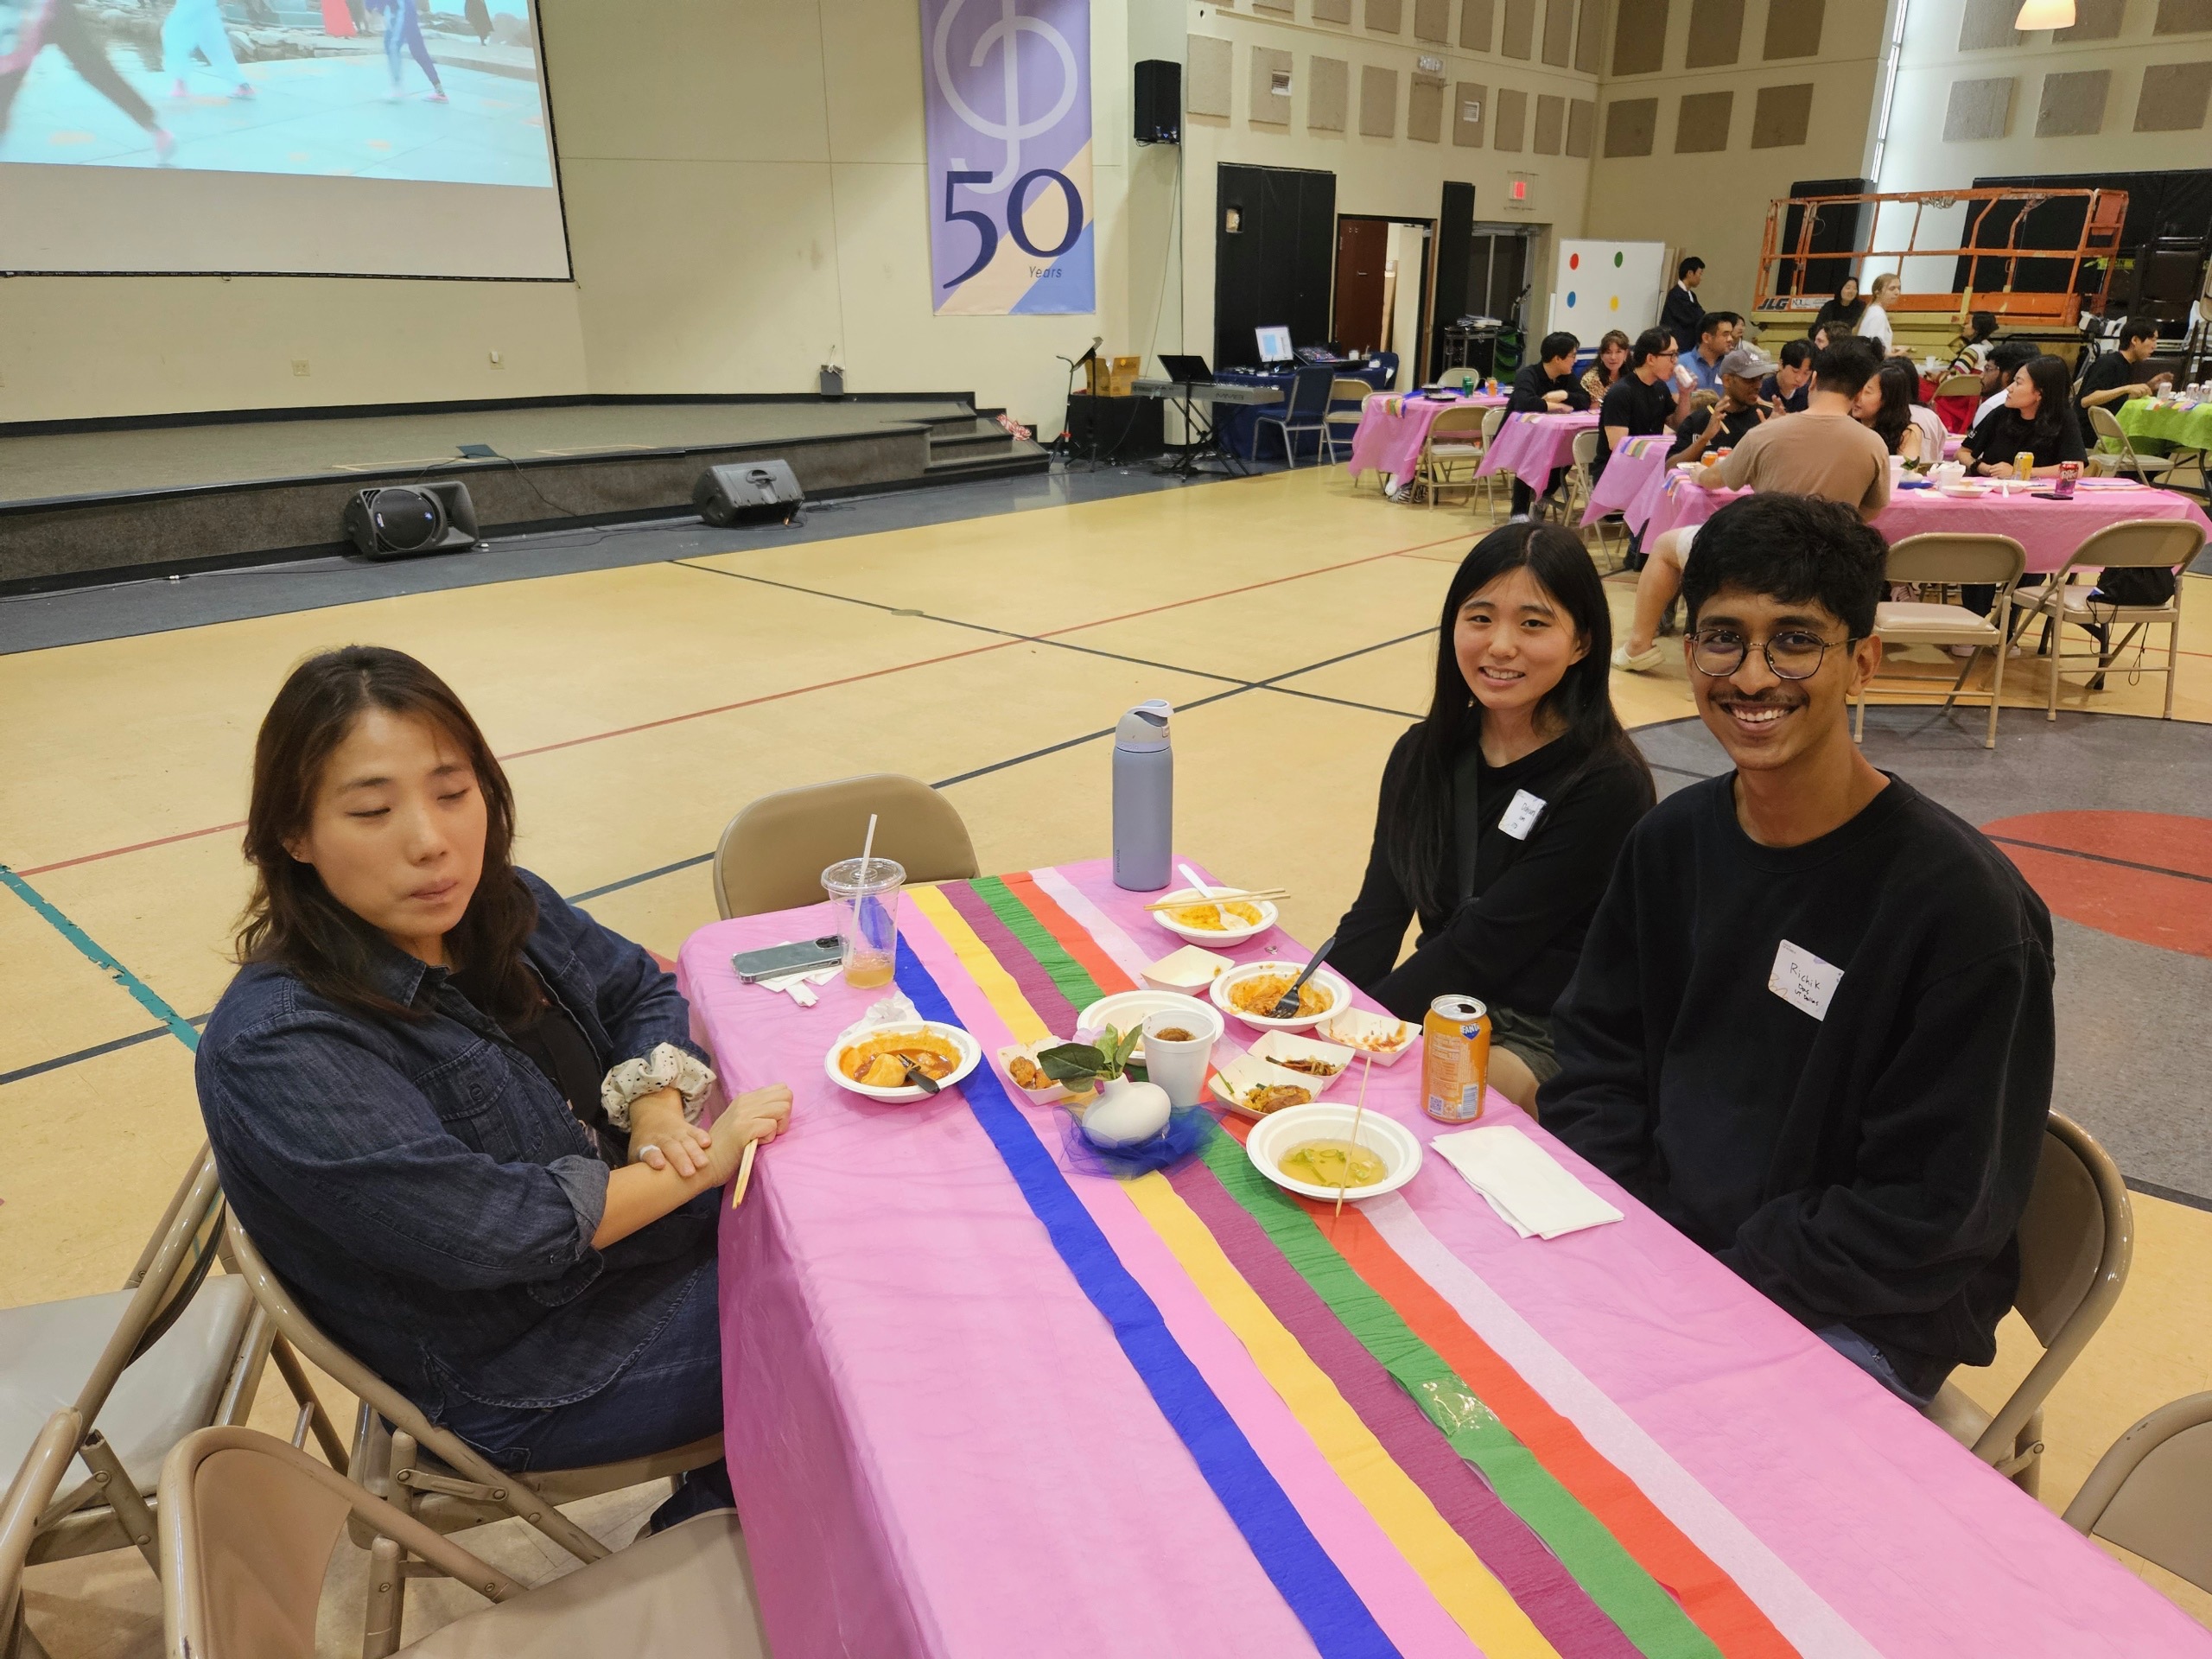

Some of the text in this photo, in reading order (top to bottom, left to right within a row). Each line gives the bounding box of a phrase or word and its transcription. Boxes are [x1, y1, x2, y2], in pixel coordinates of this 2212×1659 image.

[943, 168, 1084, 289] 50
[1028, 265, 1063, 279] Years
[1757, 297, 1789, 310] JLG
[1789, 962, 1821, 990] Richik
